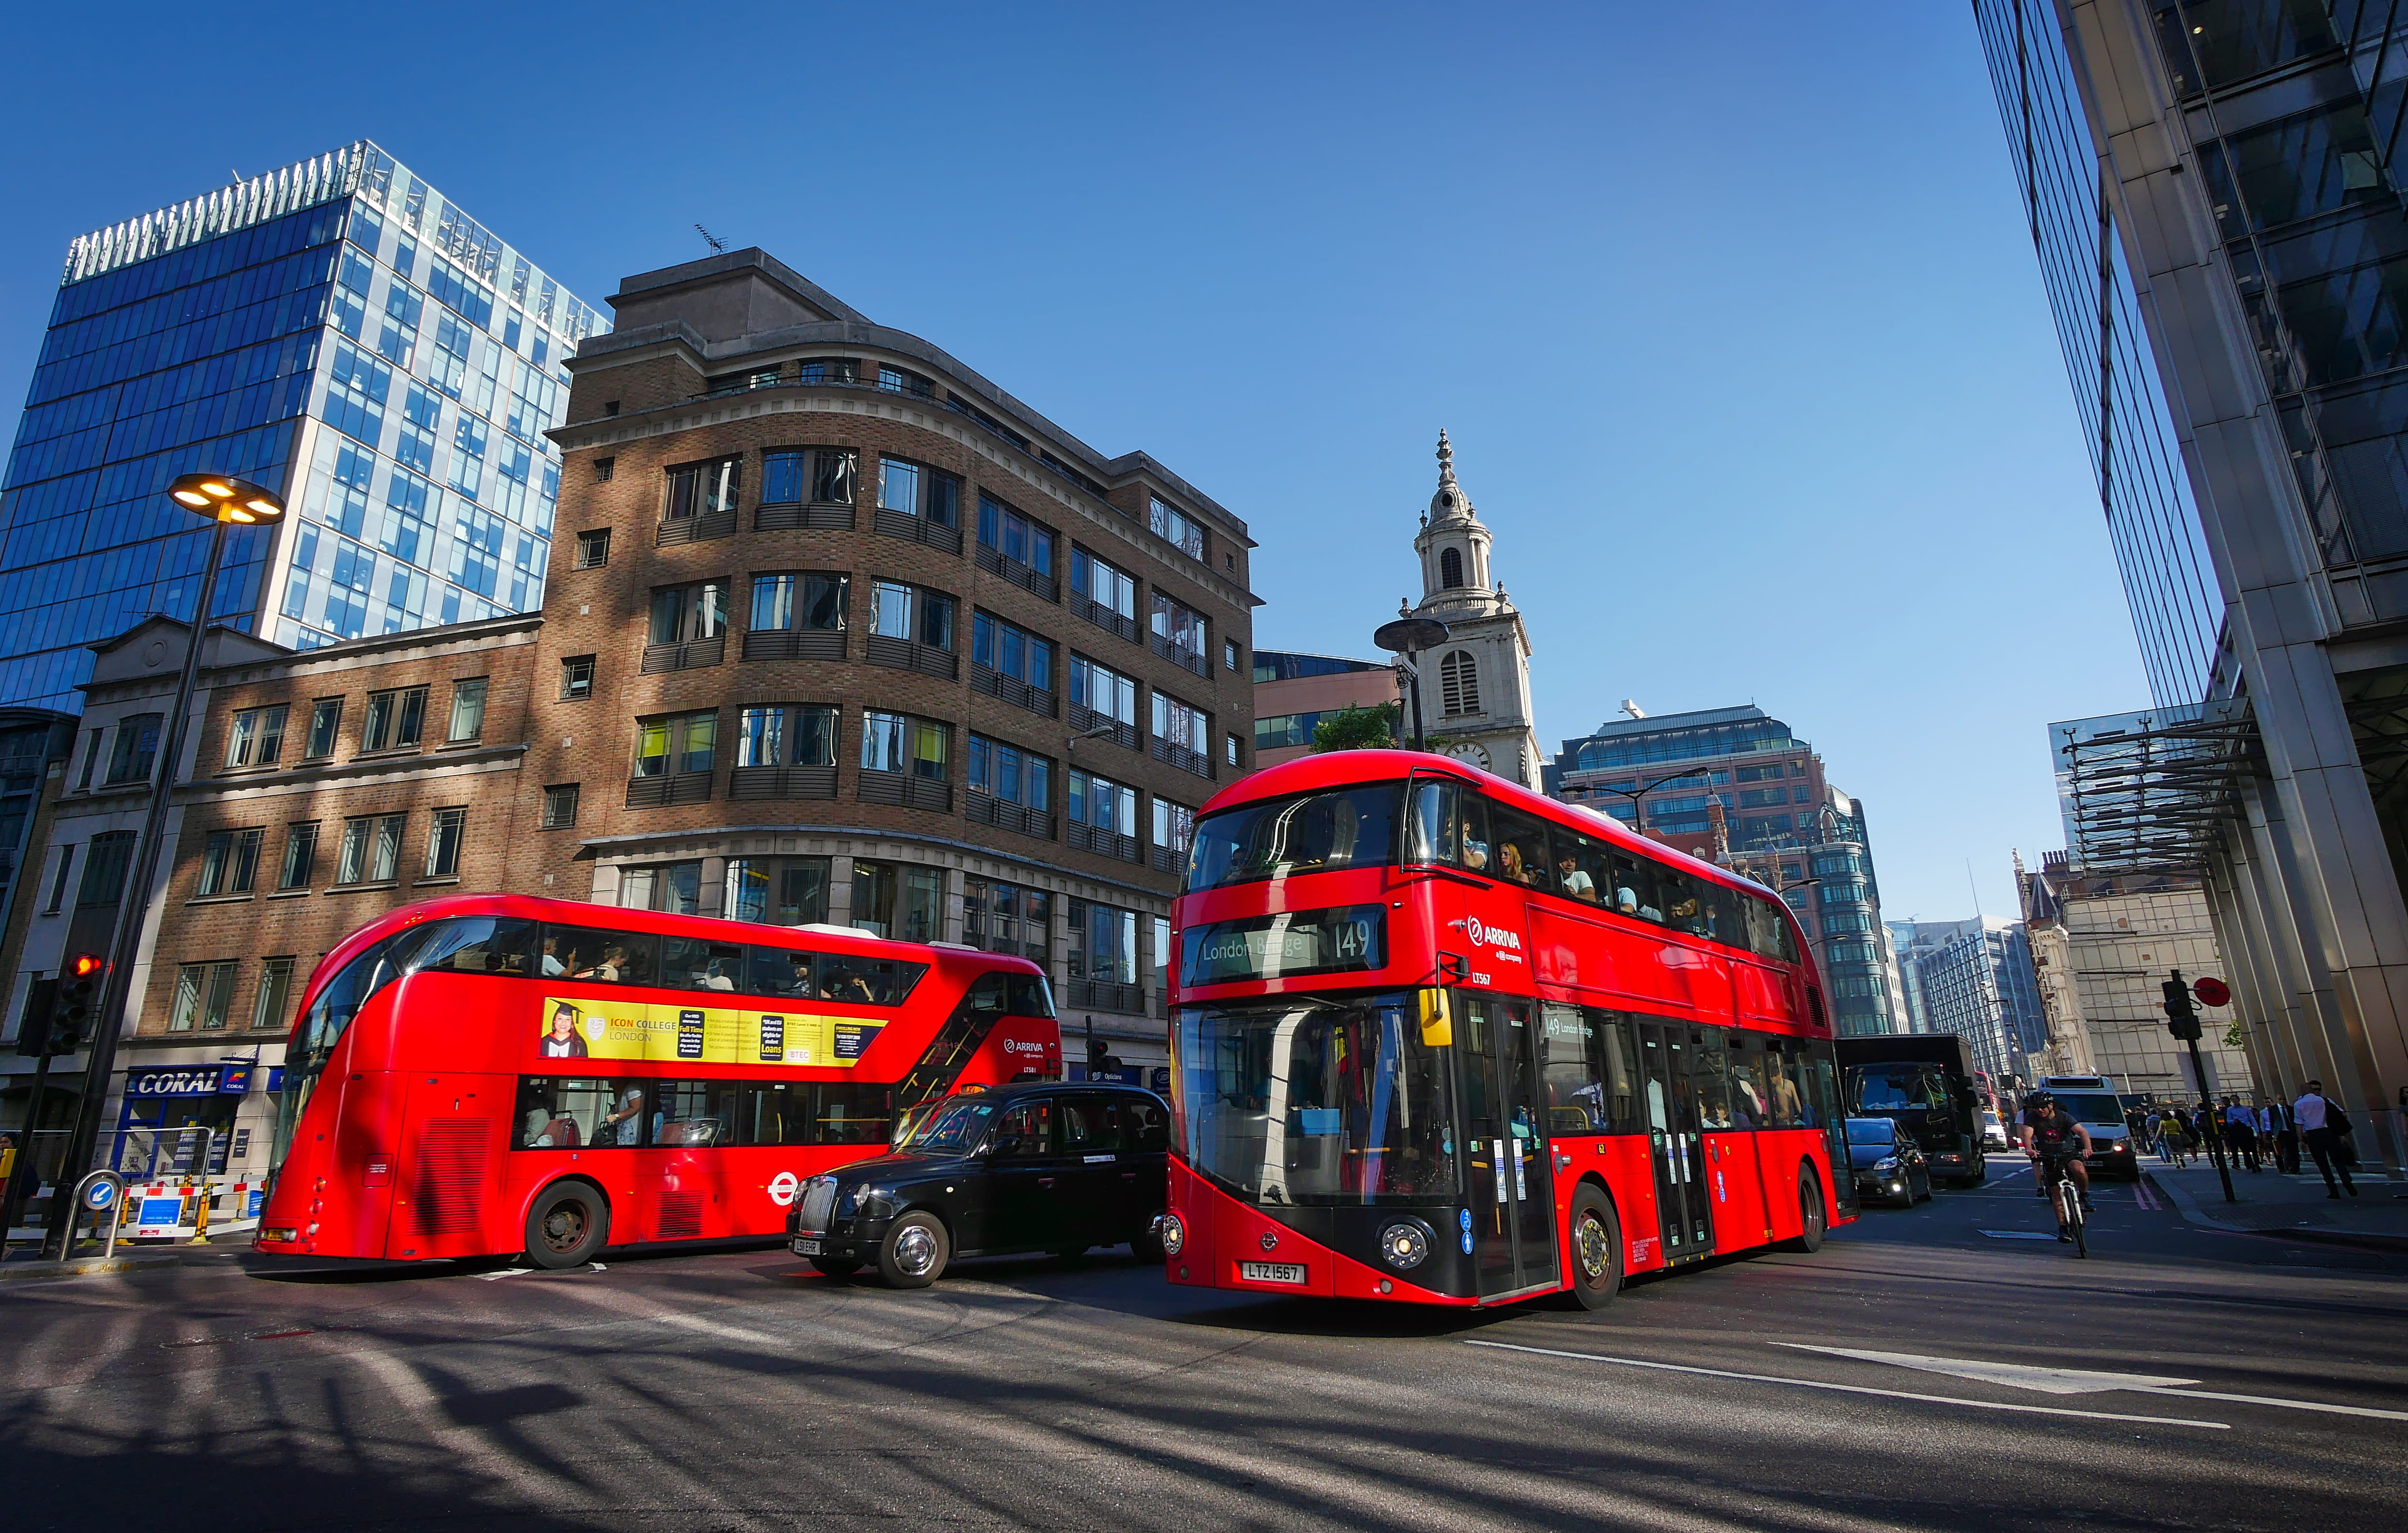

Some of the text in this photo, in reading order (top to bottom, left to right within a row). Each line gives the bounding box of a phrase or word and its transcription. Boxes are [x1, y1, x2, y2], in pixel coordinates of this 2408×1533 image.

[1336, 919, 1370, 958] 149
[1484, 926, 1521, 950] ARRIVA
[1204, 940, 1252, 961] London
[1505, 954, 1522, 964] company
[1472, 972, 1490, 985] LT567
[610, 1018, 676, 1030] ICON COLLEGE
[1546, 1018, 1593, 1038] 149 London Bridge
[610, 1032, 651, 1041] LONDON
[761, 1044, 782, 1053] Loans
[1016, 1042, 1043, 1052] ARRIVA
[139, 1071, 218, 1094] CORAL
[1598, 1144, 1605, 1154] 62
[805, 1242, 816, 1252] EHR
[1249, 1264, 1297, 1280] LTZ 1567
